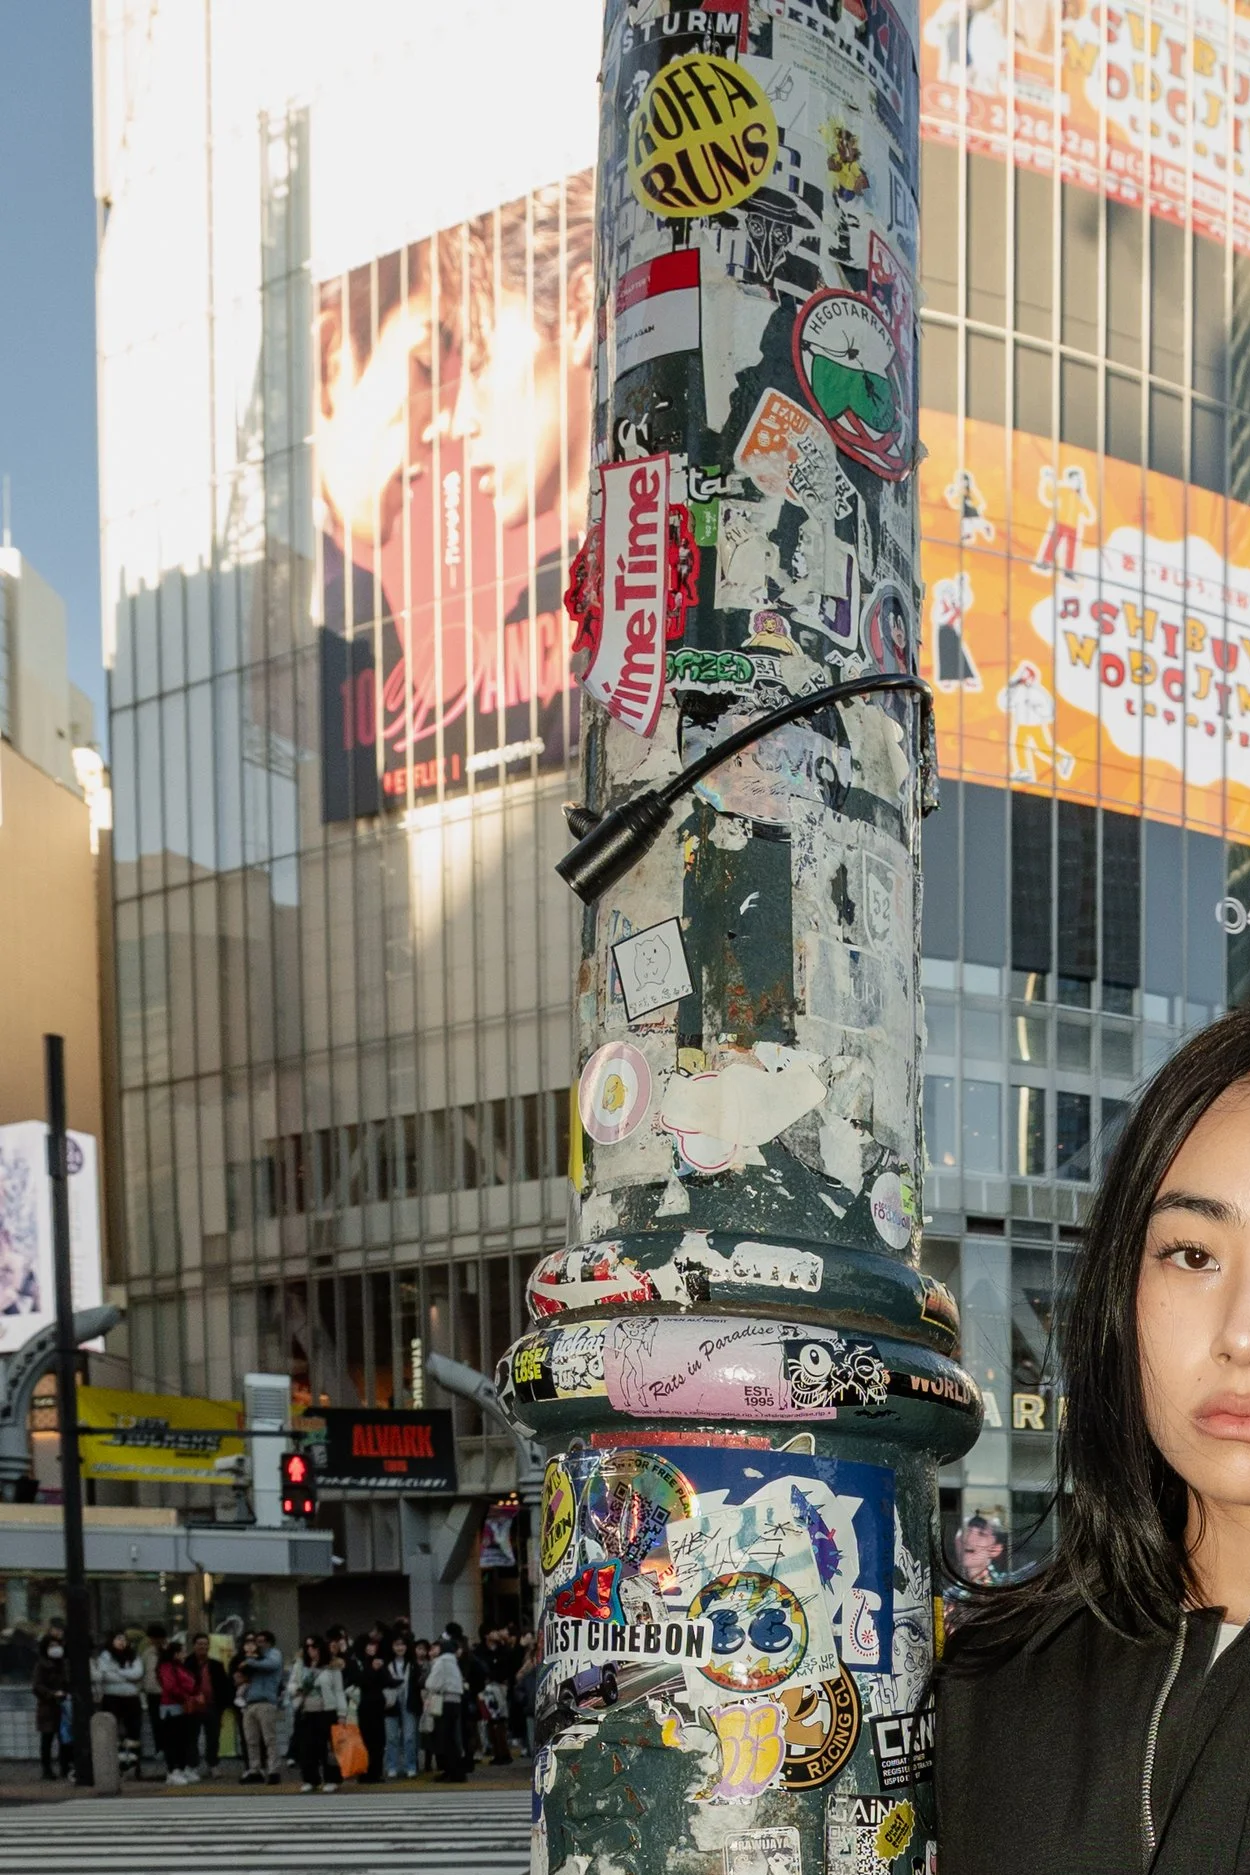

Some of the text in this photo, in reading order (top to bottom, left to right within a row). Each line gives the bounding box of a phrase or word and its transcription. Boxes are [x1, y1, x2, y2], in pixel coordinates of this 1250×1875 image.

[622, 12, 738, 54] STURM
[787, 6, 891, 92] KENNEDY
[634, 62, 758, 168] ROFFA
[640, 123, 769, 207] RUNS
[809, 301, 895, 351] HEGOTARRAK
[648, 1326, 775, 1401] Rats in Paradise
[744, 1386, 773, 1397] EST.
[744, 1397, 775, 1406] 1995
[909, 1375, 972, 1405] WORLD
[351, 1424, 435, 1459] ALVARK
[651, 1464, 678, 1488] FREE
[545, 1619, 705, 1659] WEST CIREBON
[796, 1665, 816, 1679] MY
[818, 1661, 837, 1673] INK
[820, 1653, 835, 1664] UP
[807, 1713, 853, 1779] RACING
[881, 1757, 908, 1768] COMBAT
